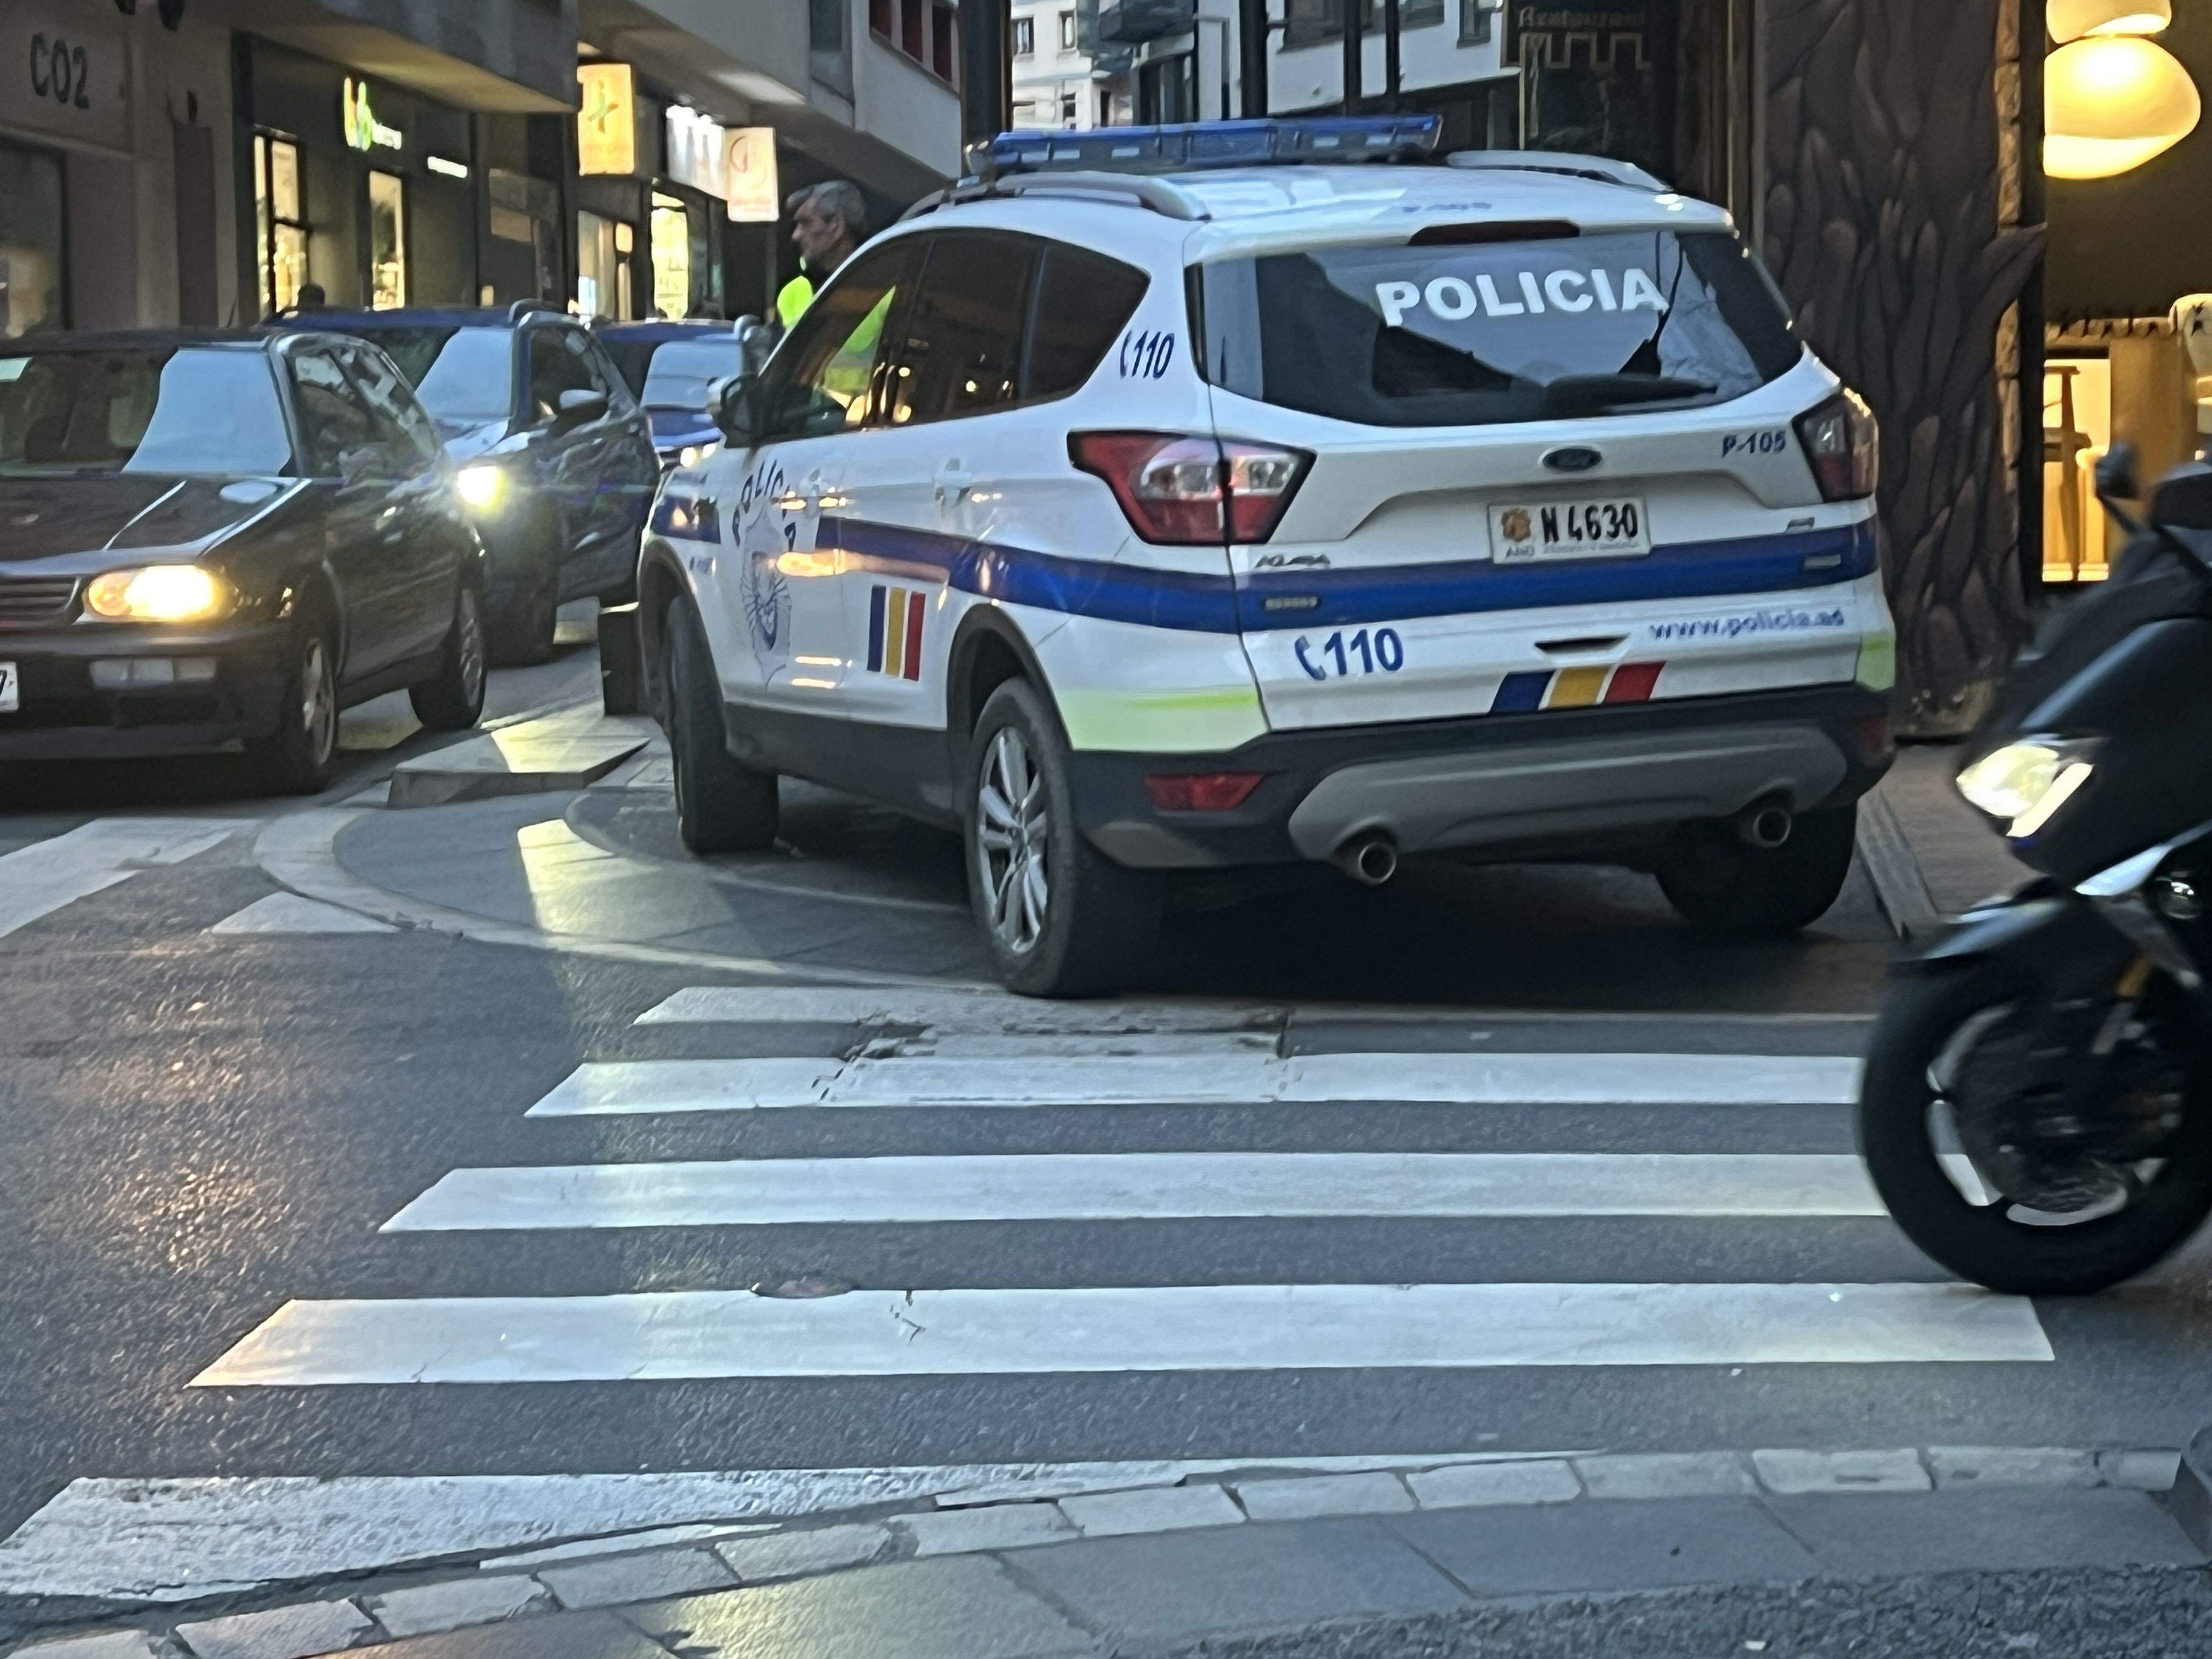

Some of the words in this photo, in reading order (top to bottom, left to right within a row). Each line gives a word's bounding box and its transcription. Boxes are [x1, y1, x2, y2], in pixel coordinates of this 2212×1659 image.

[30, 33, 89, 109] CO2
[1376, 268, 1669, 326] POLICIA
[1131, 330, 1175, 380] 110
[1324, 628, 1403, 676] 110
